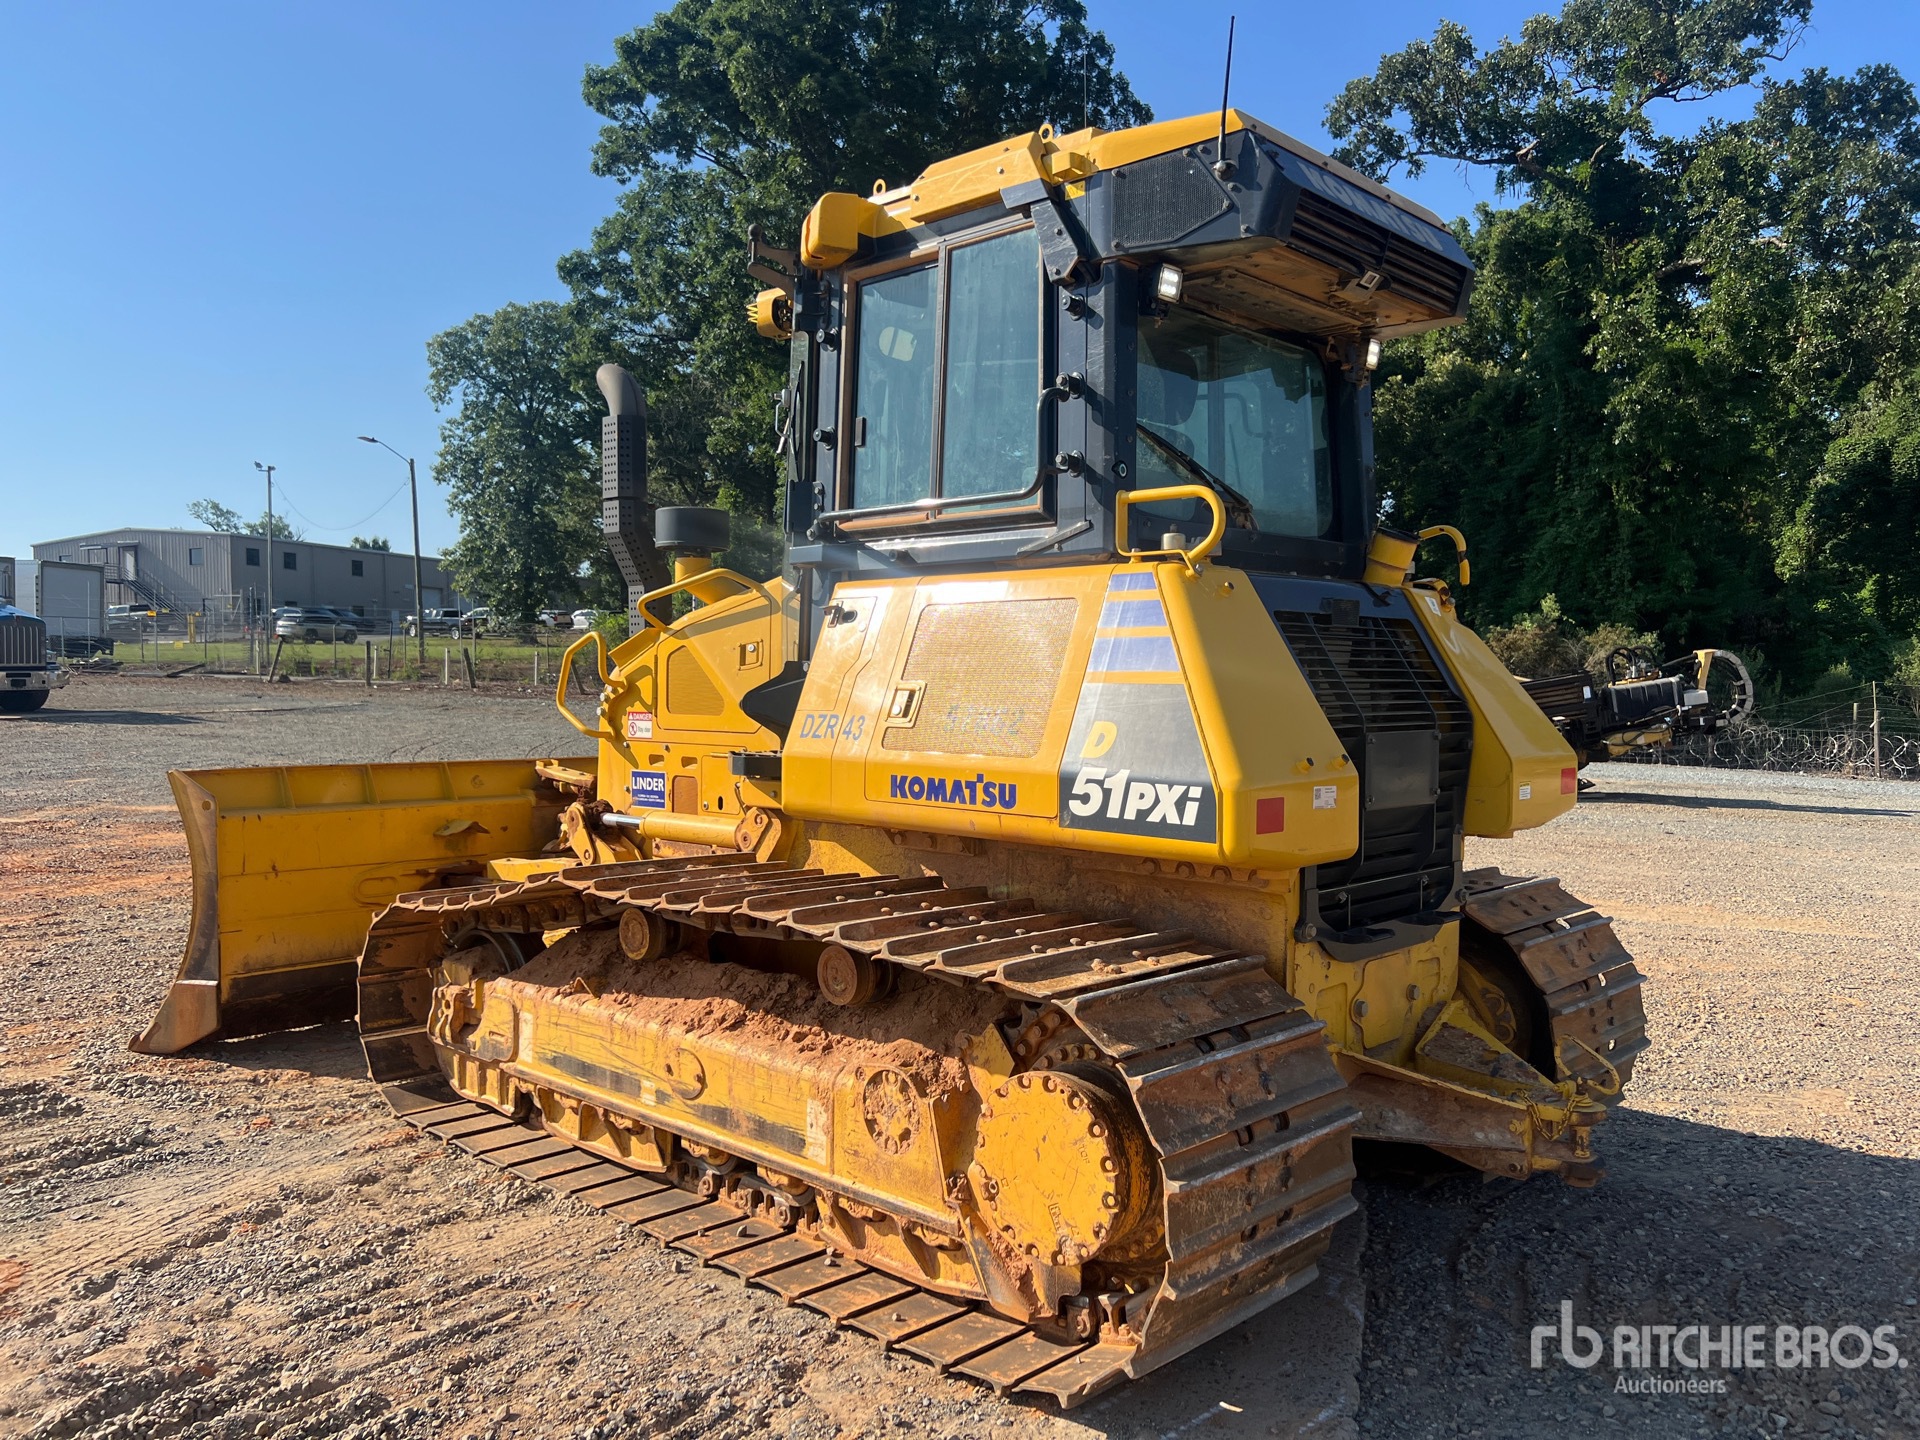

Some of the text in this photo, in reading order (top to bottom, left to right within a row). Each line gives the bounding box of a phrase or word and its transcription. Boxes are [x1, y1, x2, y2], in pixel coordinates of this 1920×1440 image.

[800, 714, 865, 741] DZR 43
[1079, 721, 1118, 759] D
[632, 776, 665, 792] LINDER
[890, 773, 1017, 810] KOMATSU
